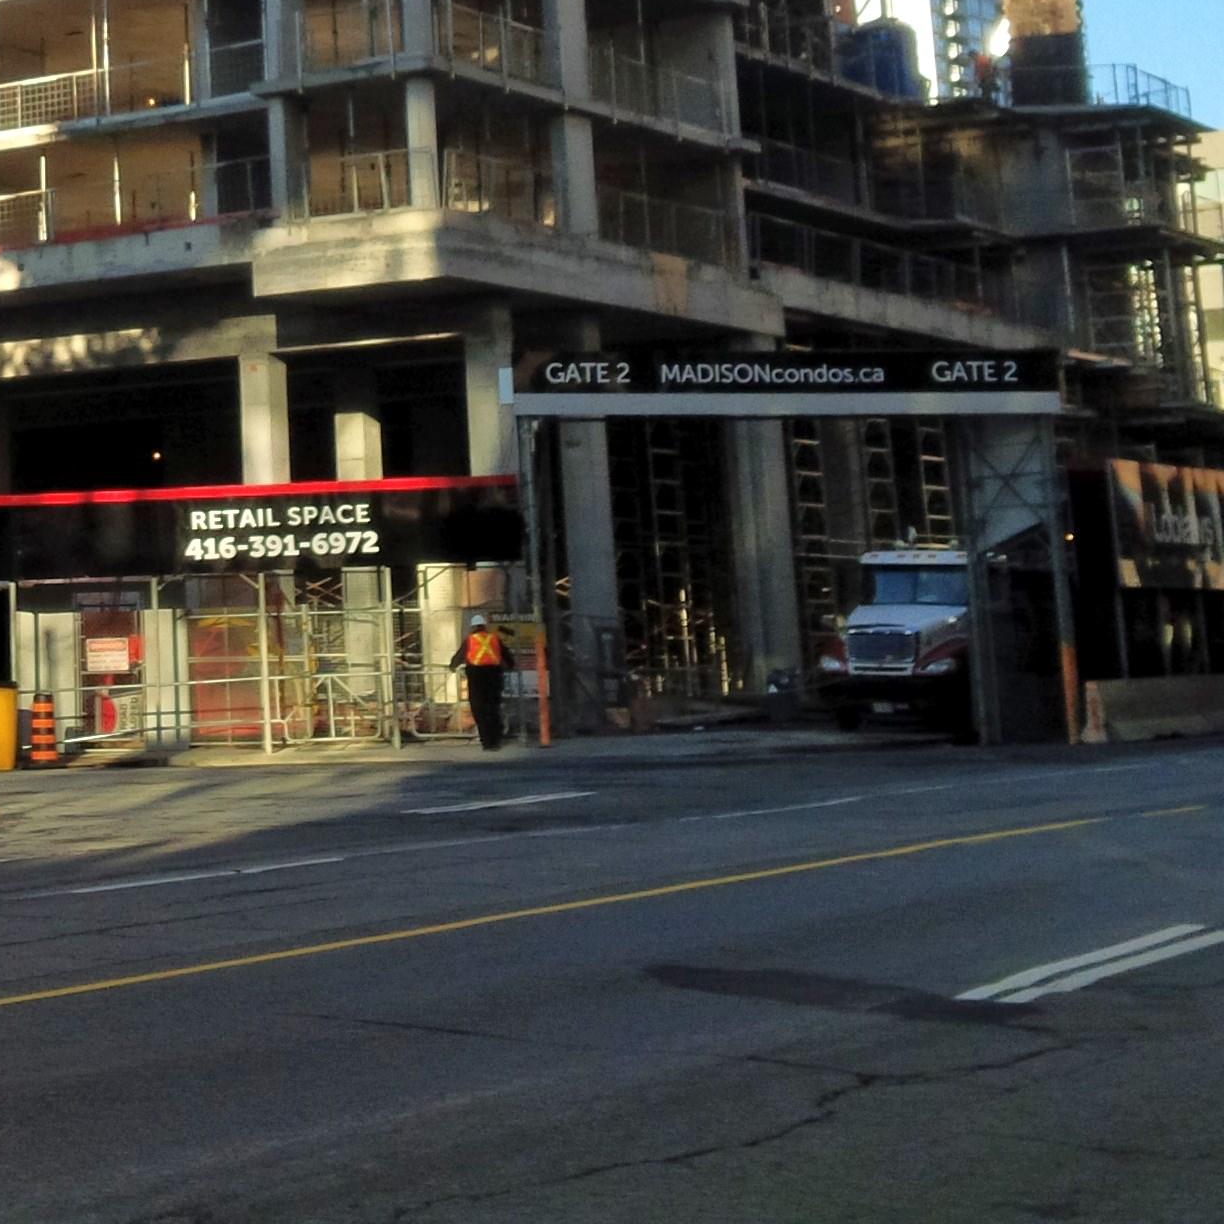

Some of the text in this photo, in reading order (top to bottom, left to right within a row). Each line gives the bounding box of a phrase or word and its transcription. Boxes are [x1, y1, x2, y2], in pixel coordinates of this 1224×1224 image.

[545, 360, 1018, 385] GATE 2 MADISONcondos.ca GATE 2
[190, 503, 371, 530] RETAIL SPACE
[184, 530, 380, 561] 416-391-6972
